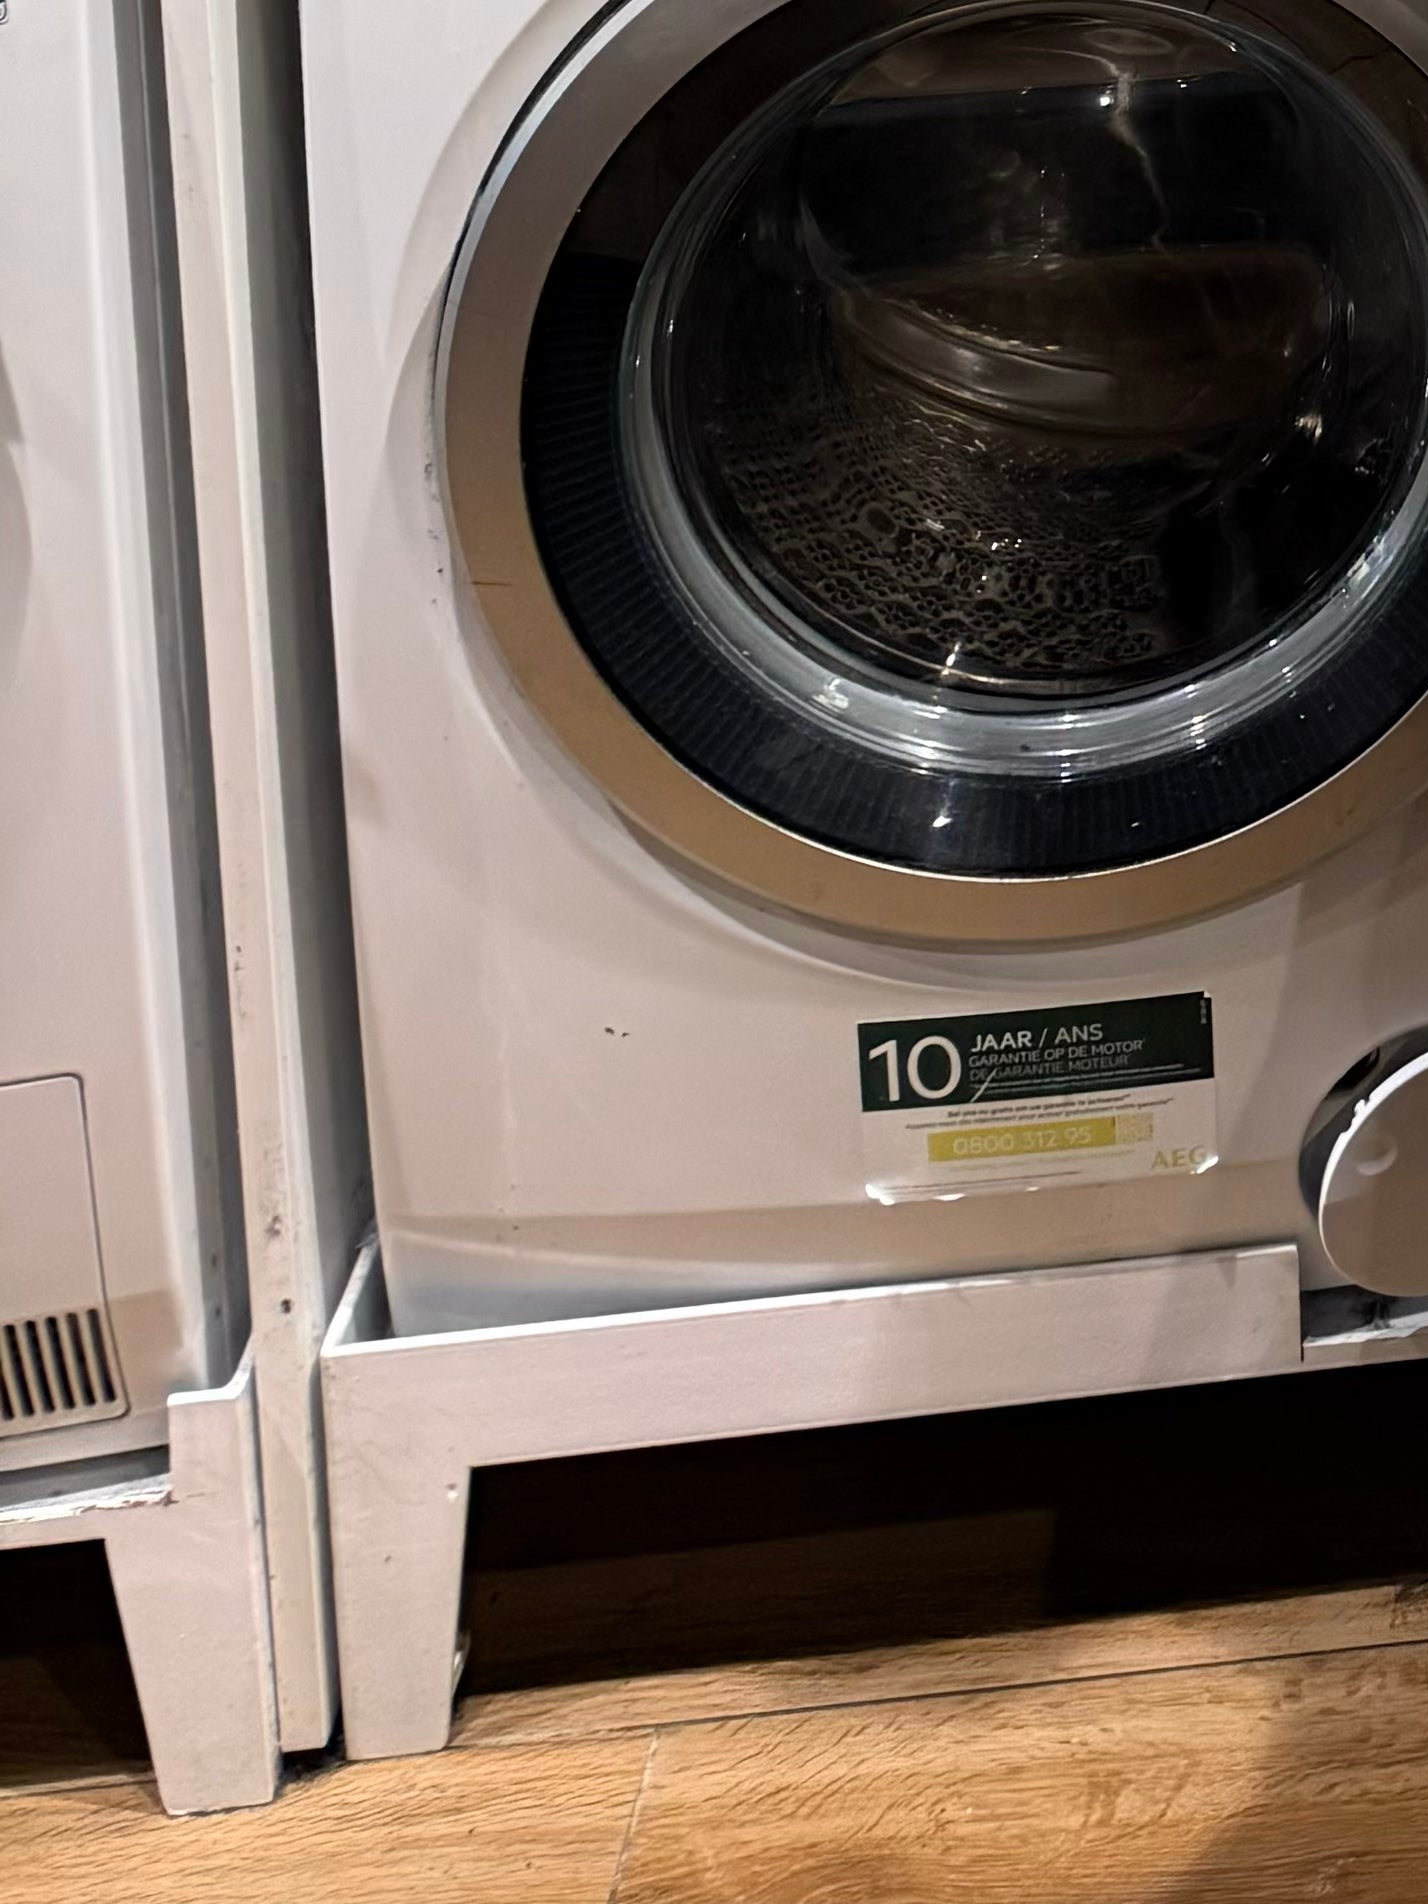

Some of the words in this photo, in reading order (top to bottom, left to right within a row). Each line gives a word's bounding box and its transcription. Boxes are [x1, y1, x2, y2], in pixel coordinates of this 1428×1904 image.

[867, 1034, 963, 1103] 10
[970, 1029, 1033, 1053] JAAR
[1054, 1023, 1104, 1045] ANS
[969, 1050, 1041, 1068] GARANTIE
[1043, 1048, 1065, 1061] OP
[1067, 1045, 1088, 1059] DE
[952, 1135, 1014, 1155] 0800
[1069, 1125, 1092, 1144] 95
[1151, 1146, 1207, 1171] AEG
